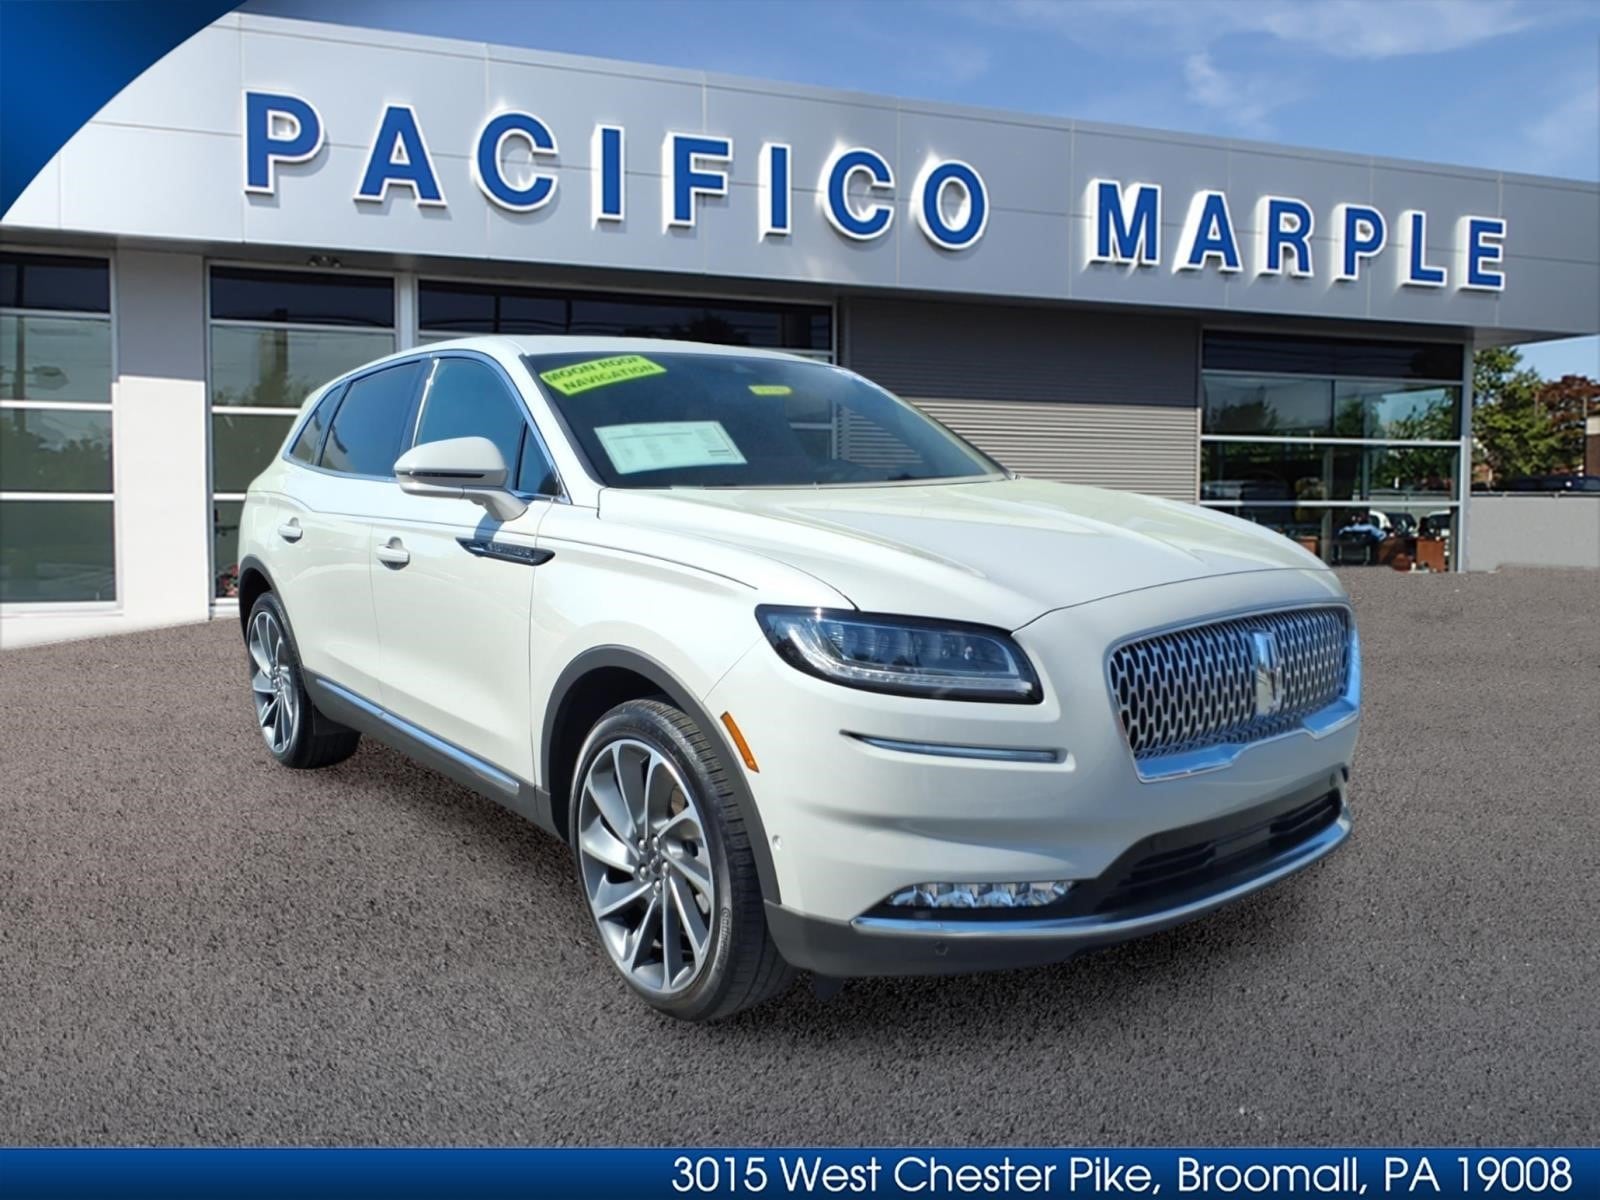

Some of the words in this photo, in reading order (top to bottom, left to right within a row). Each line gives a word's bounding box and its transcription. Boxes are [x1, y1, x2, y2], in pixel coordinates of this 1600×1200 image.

[244, 90, 990, 251] PACIFICO
[1086, 178, 1506, 292] MARPLE
[544, 363, 597, 383] MOON
[597, 356, 639, 370] ROOF
[562, 364, 656, 391] NAVIGATION
